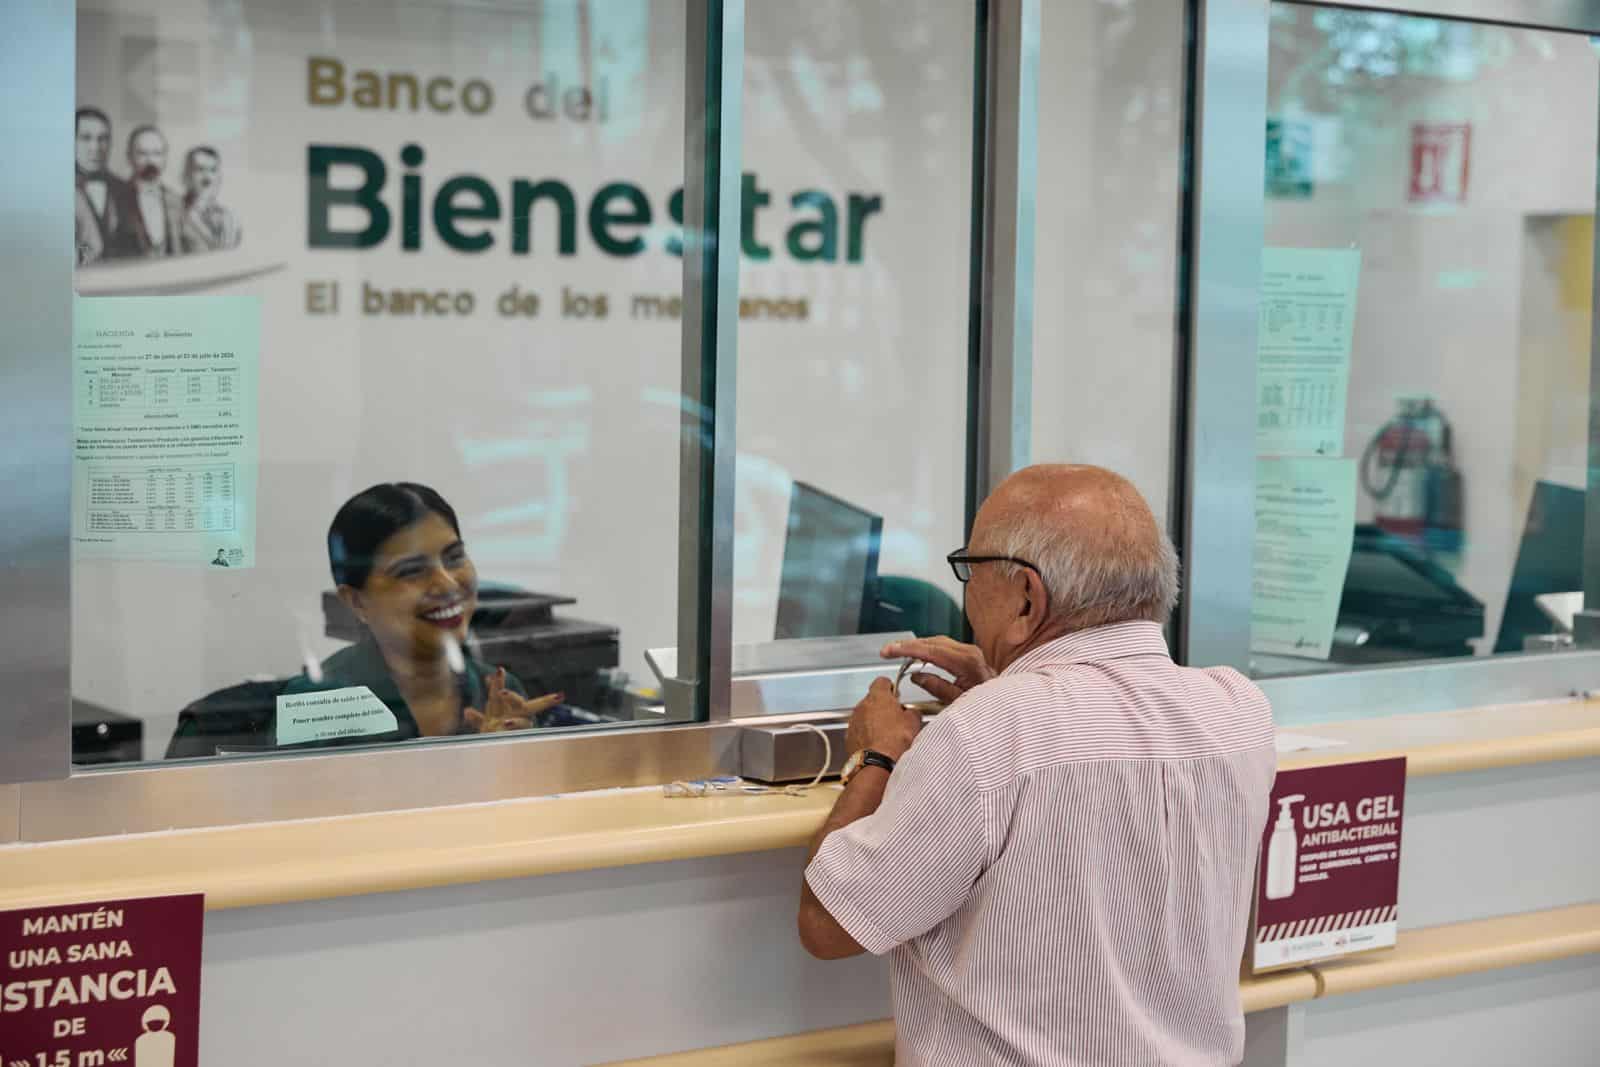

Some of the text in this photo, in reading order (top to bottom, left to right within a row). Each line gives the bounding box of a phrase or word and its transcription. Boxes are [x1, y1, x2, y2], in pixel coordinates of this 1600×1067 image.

[306, 55, 609, 124] Banco del
[305, 281, 809, 321] El banco de los meanos
[1303, 796, 1400, 829] USA GEL
[1301, 822, 1399, 848] ANTIBACTERIAL
[22, 906, 125, 937] MANTÉN
[9, 939, 135, 970] UNA SANA
[53, 1016, 87, 1039] DE
[78, 1048, 105, 1067] m
